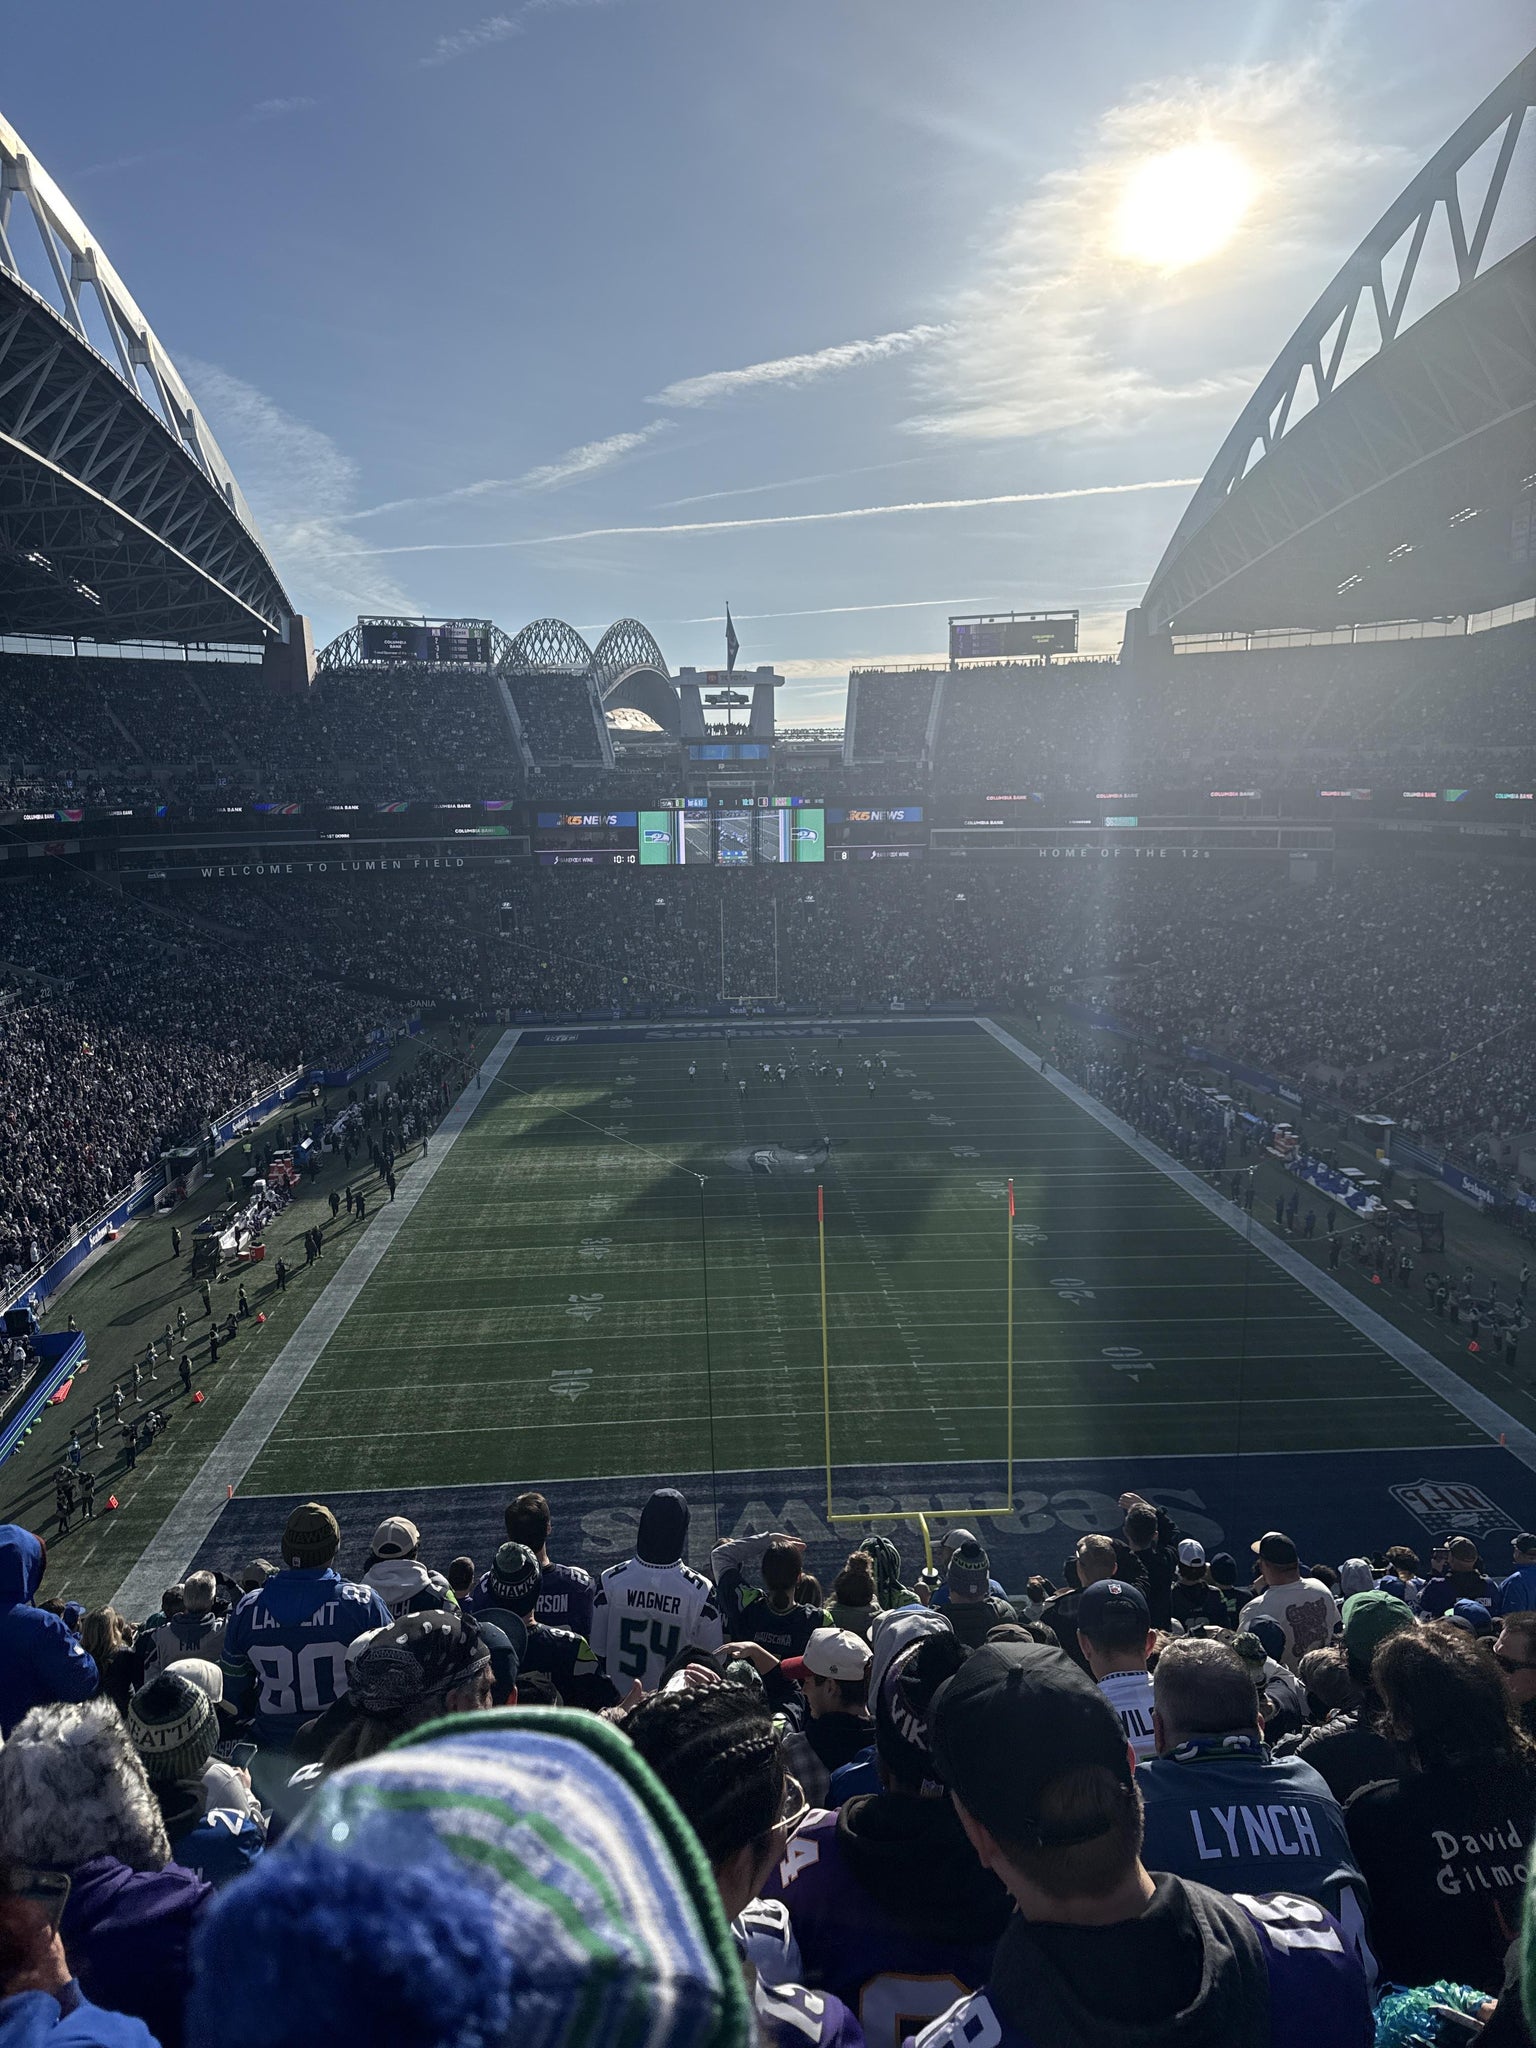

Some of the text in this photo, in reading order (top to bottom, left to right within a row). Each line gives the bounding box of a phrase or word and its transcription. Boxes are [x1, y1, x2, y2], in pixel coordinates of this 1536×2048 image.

[583, 815, 618, 825] NEWS
[871, 811, 905, 821] NEWS
[841, 851, 847, 860] 8
[1039, 849, 1087, 857] HOME
[1101, 849, 1121, 857] OF
[1134, 849, 1168, 858] THE
[201, 858, 464, 877] WELCOME TO LUMEN FIELD
[729, 1006, 766, 1014] Seahks
[1050, 1278, 1096, 1299] 20
[565, 1293, 605, 1316] 20
[1102, 1346, 1156, 1371] 10
[548, 1367, 594, 1393] 10
[1402, 1485, 1490, 1511] NFL
[536, 1594, 569, 1613] RSON
[627, 1589, 681, 1615] WAGNER
[619, 1617, 681, 1679] 54
[247, 1641, 353, 1715] 80
[890, 1692, 931, 1752] VIK
[1190, 1804, 1322, 1861] LYNCH
[1432, 1819, 1523, 1861] David
[1436, 1863, 1528, 1896] Gilmo
